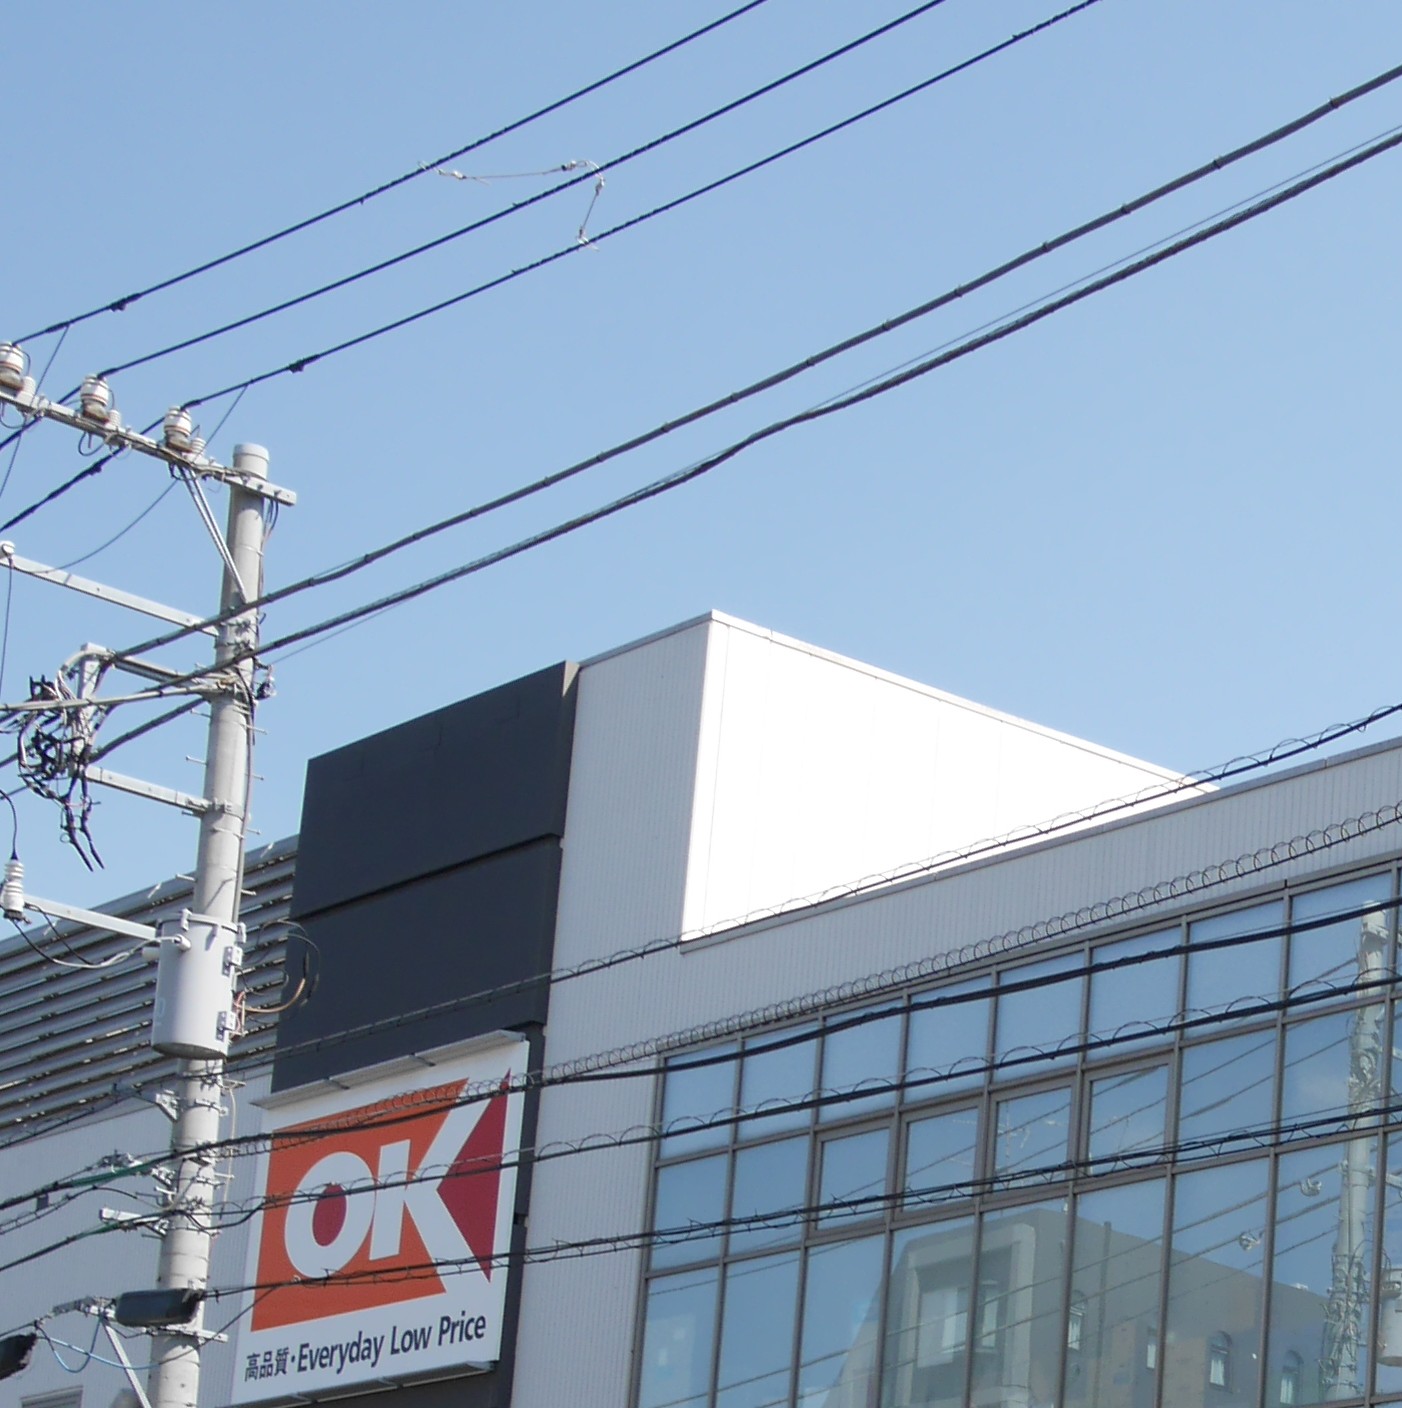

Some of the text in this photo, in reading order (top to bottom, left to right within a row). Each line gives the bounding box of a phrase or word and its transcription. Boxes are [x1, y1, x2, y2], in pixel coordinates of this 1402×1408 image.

[282, 1080, 498, 1292] OK
[244, 1310, 487, 1382] 高品質・Everyday Low Price
